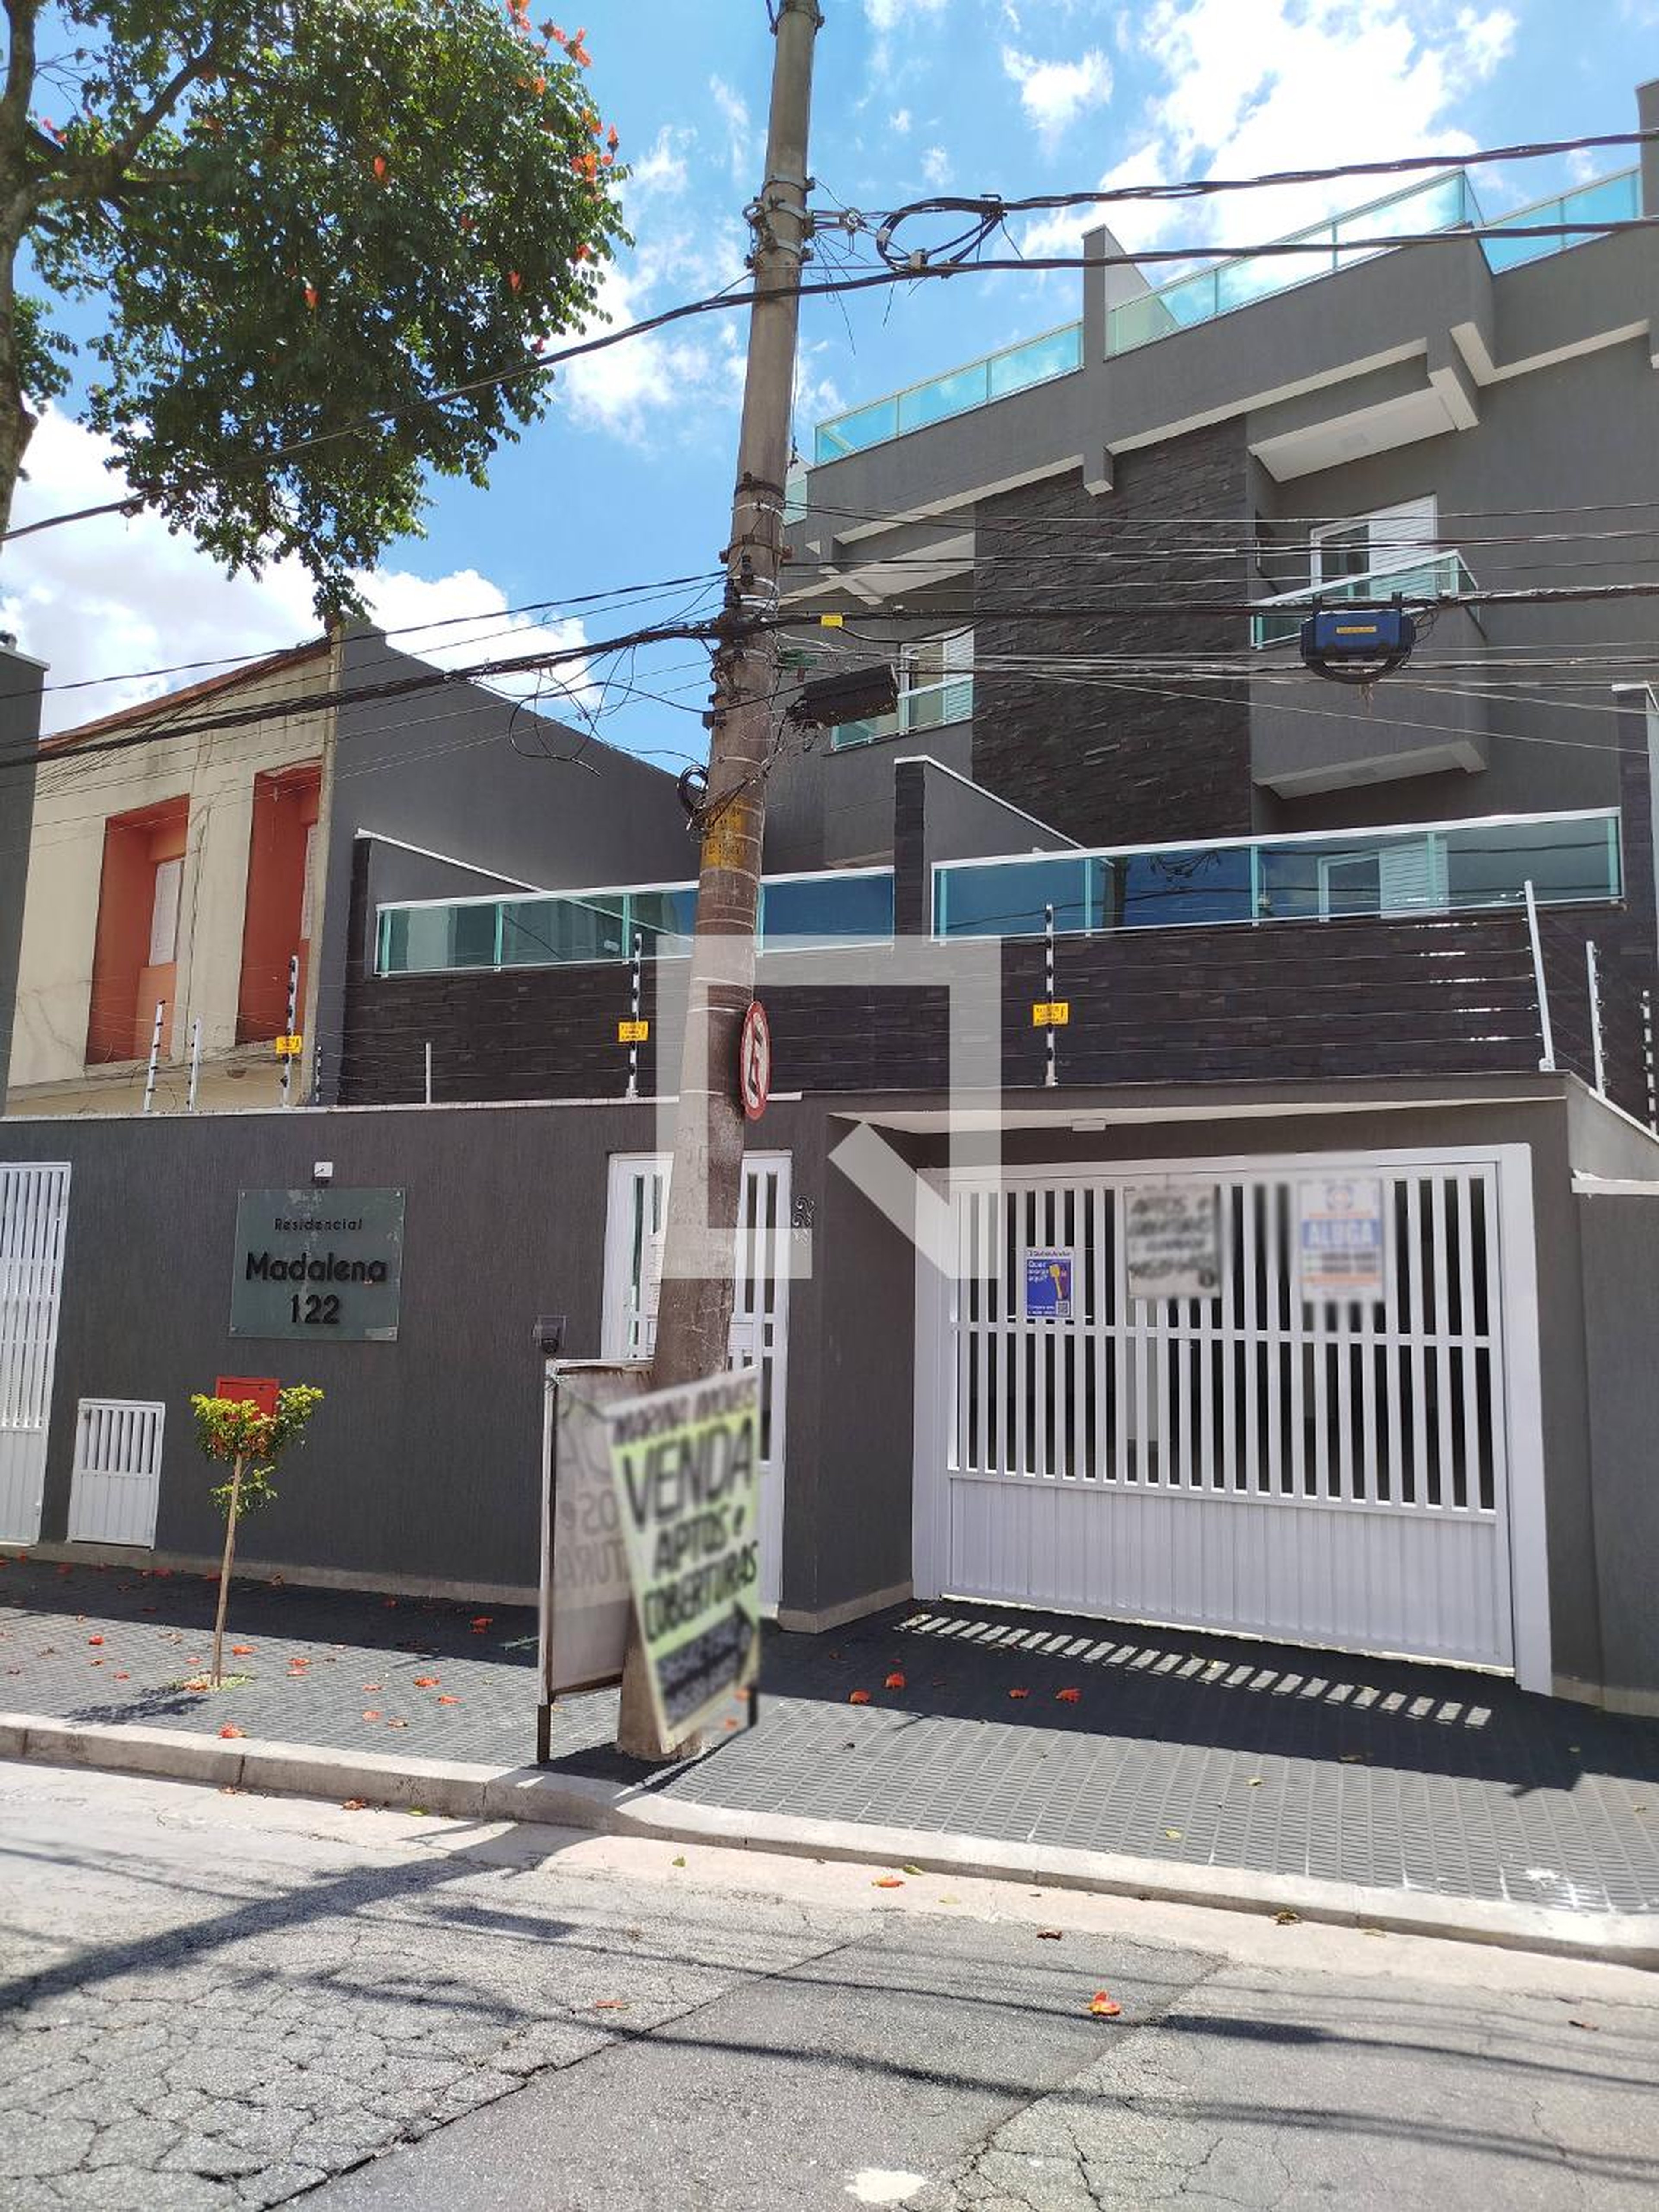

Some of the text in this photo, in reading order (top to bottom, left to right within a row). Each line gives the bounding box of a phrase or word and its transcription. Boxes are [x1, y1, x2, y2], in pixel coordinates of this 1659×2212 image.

[274, 1217, 362, 1231] Residencial
[246, 1252, 387, 1281] Madalena
[291, 1294, 340, 1324] 122
[622, 1415, 752, 1532] VENDA
